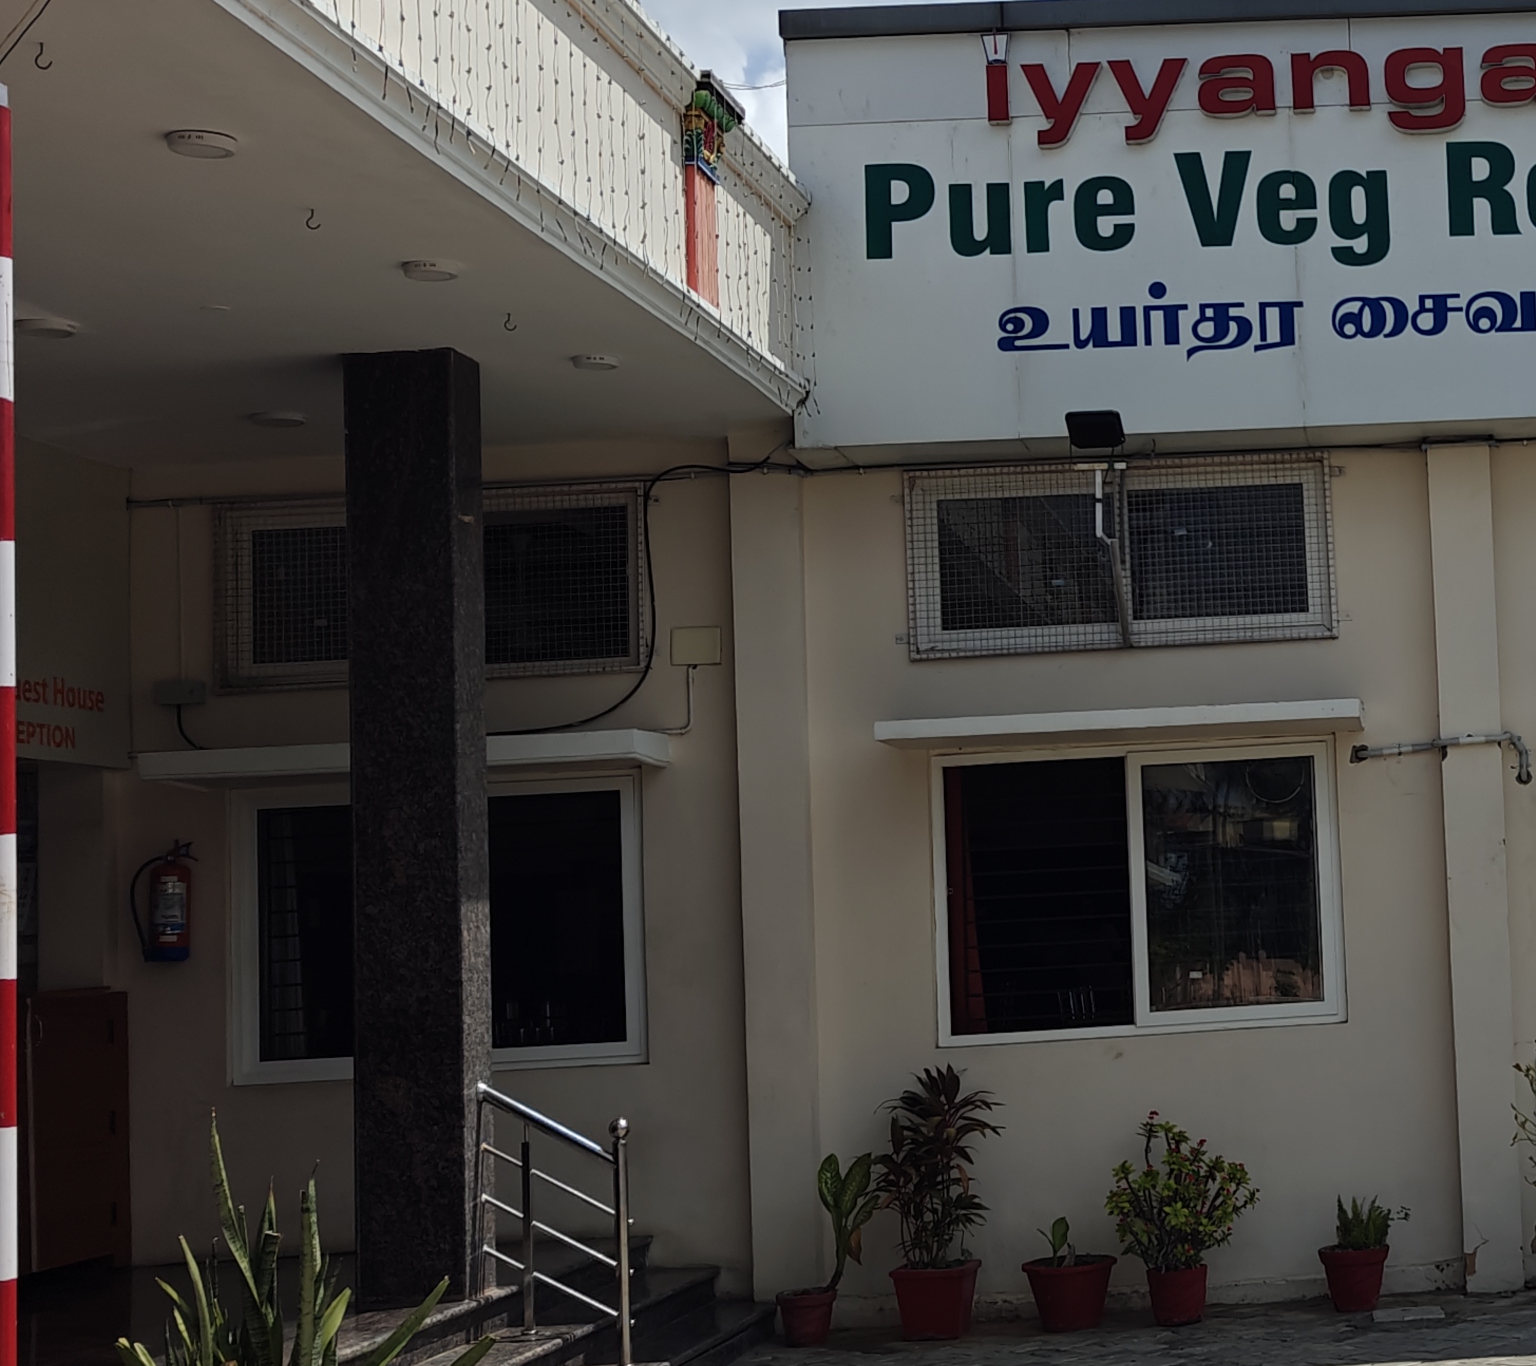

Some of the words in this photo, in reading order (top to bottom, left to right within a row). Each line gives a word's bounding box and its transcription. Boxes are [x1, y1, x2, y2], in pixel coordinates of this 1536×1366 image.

[863, 162, 1136, 261] Pure
[1173, 149, 1392, 268] Veg
[996, 280, 1304, 362] உயர்தர
[52, 677, 105, 712] House
[15, 720, 76, 750] EPTION
